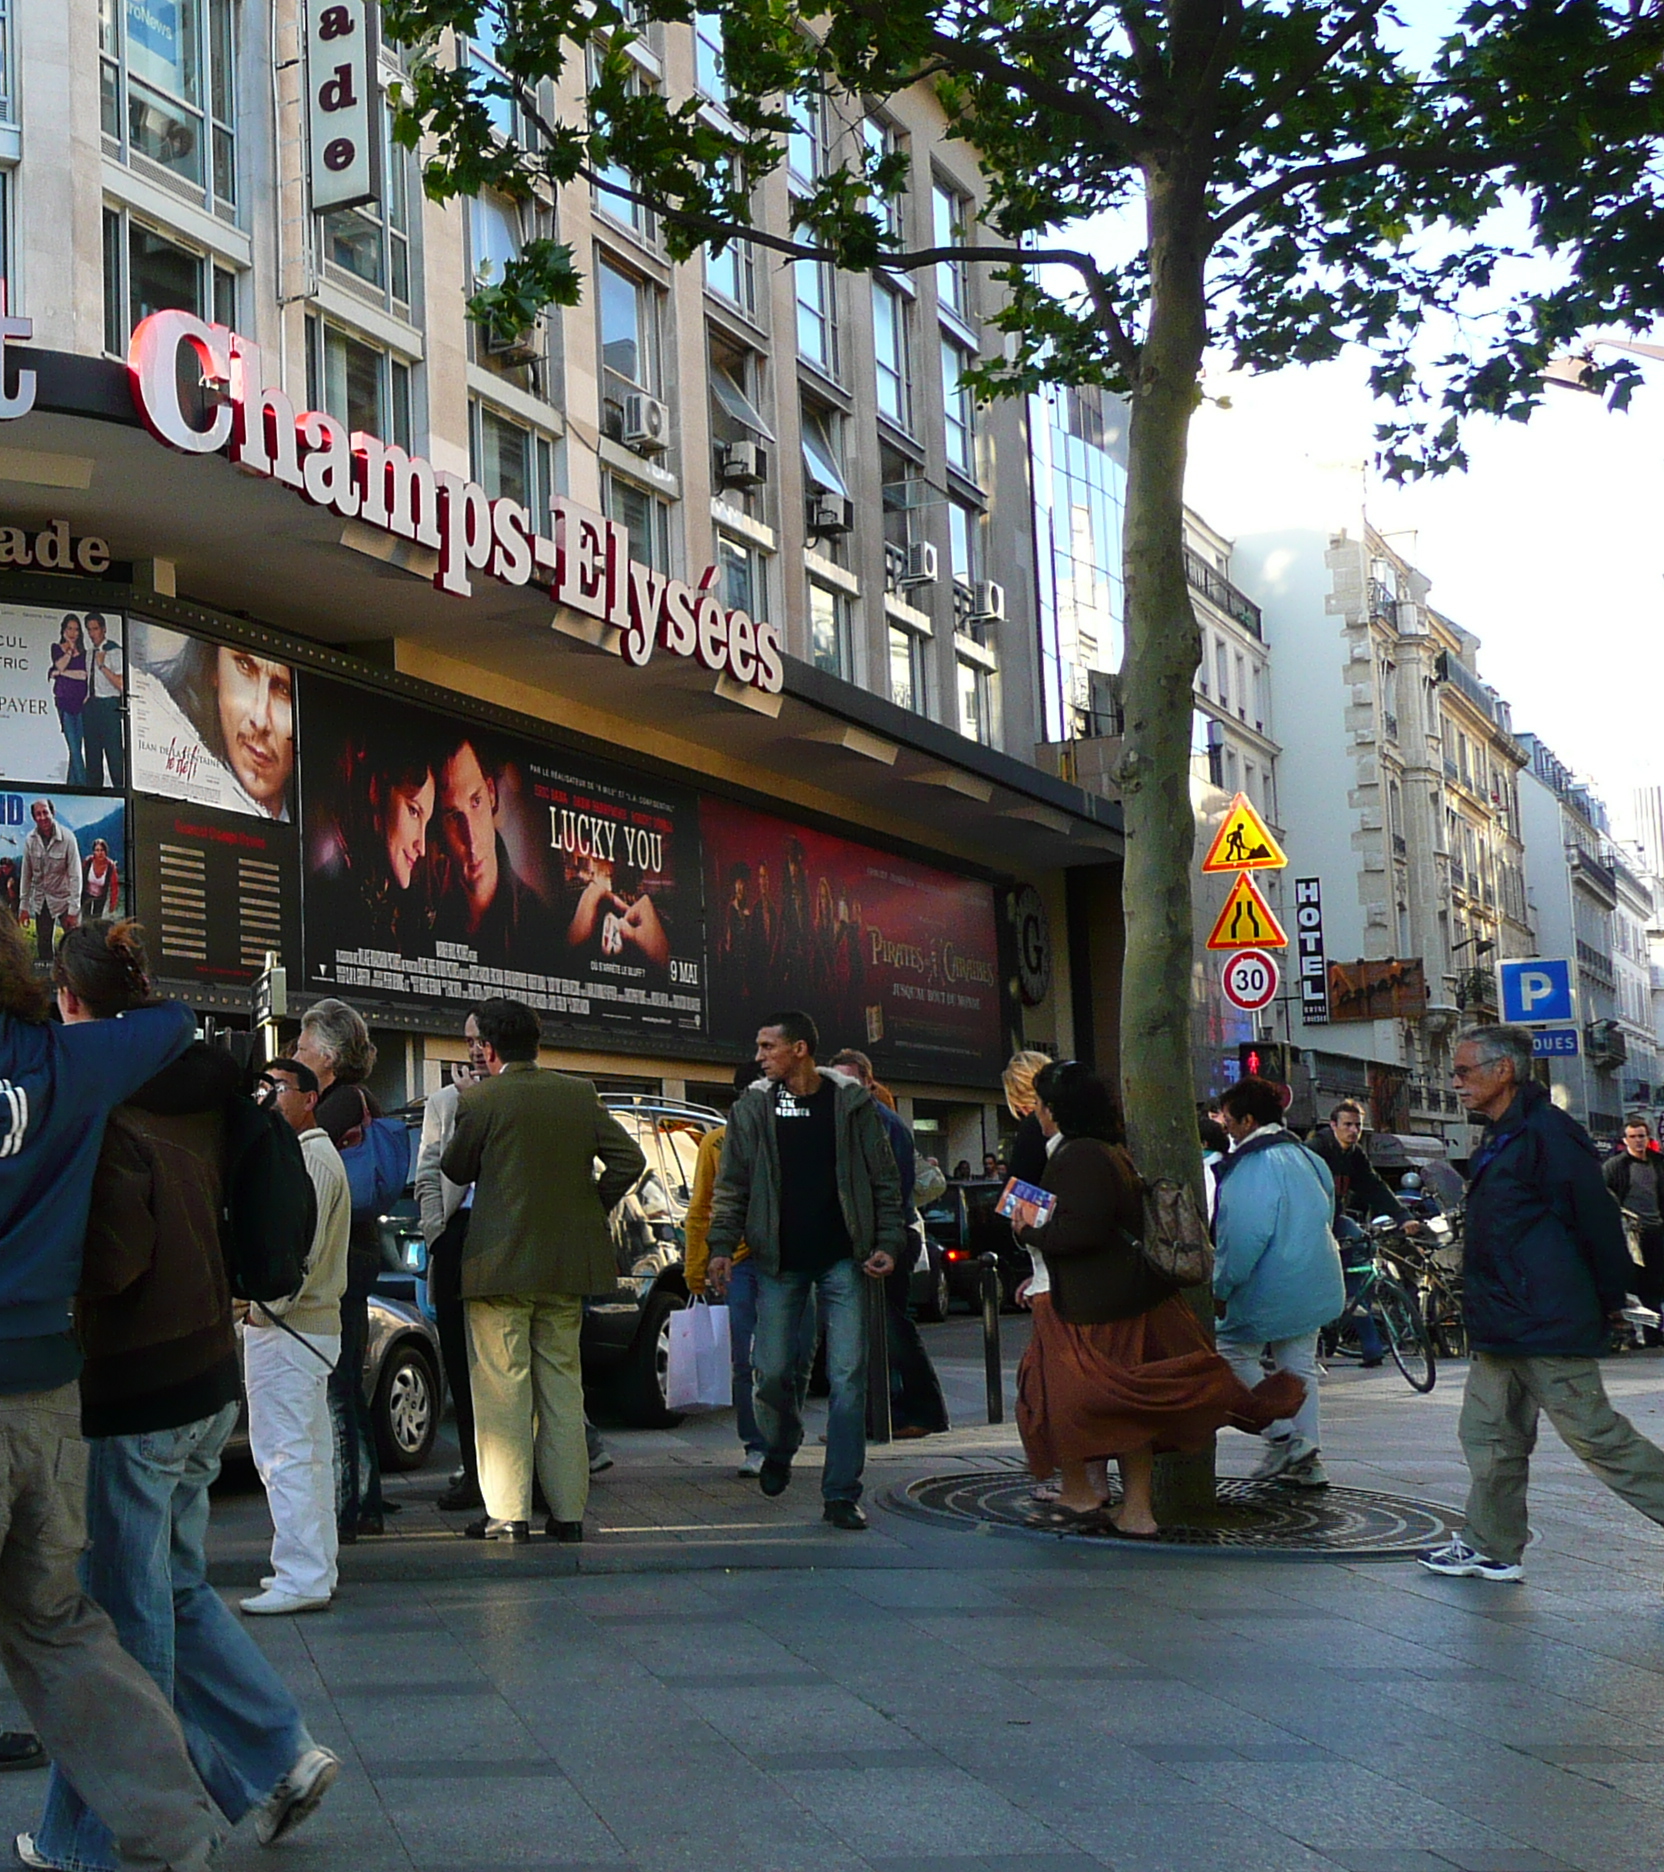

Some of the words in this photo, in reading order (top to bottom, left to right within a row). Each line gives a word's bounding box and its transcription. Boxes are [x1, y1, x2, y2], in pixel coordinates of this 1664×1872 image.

[128, 309, 783, 693] Champs-Elysées
[138, 739, 158, 752] JEAN
[549, 806, 616, 862] LUCKY
[623, 826, 663, 873] YOU
[1023, 913, 1043, 975] G
[1297, 882, 1324, 1000] HOTEL
[670, 959, 678, 982] 9
[678, 961, 698, 985] MAI
[1236, 969, 1264, 992] 30
[1520, 972, 1553, 1012] P
